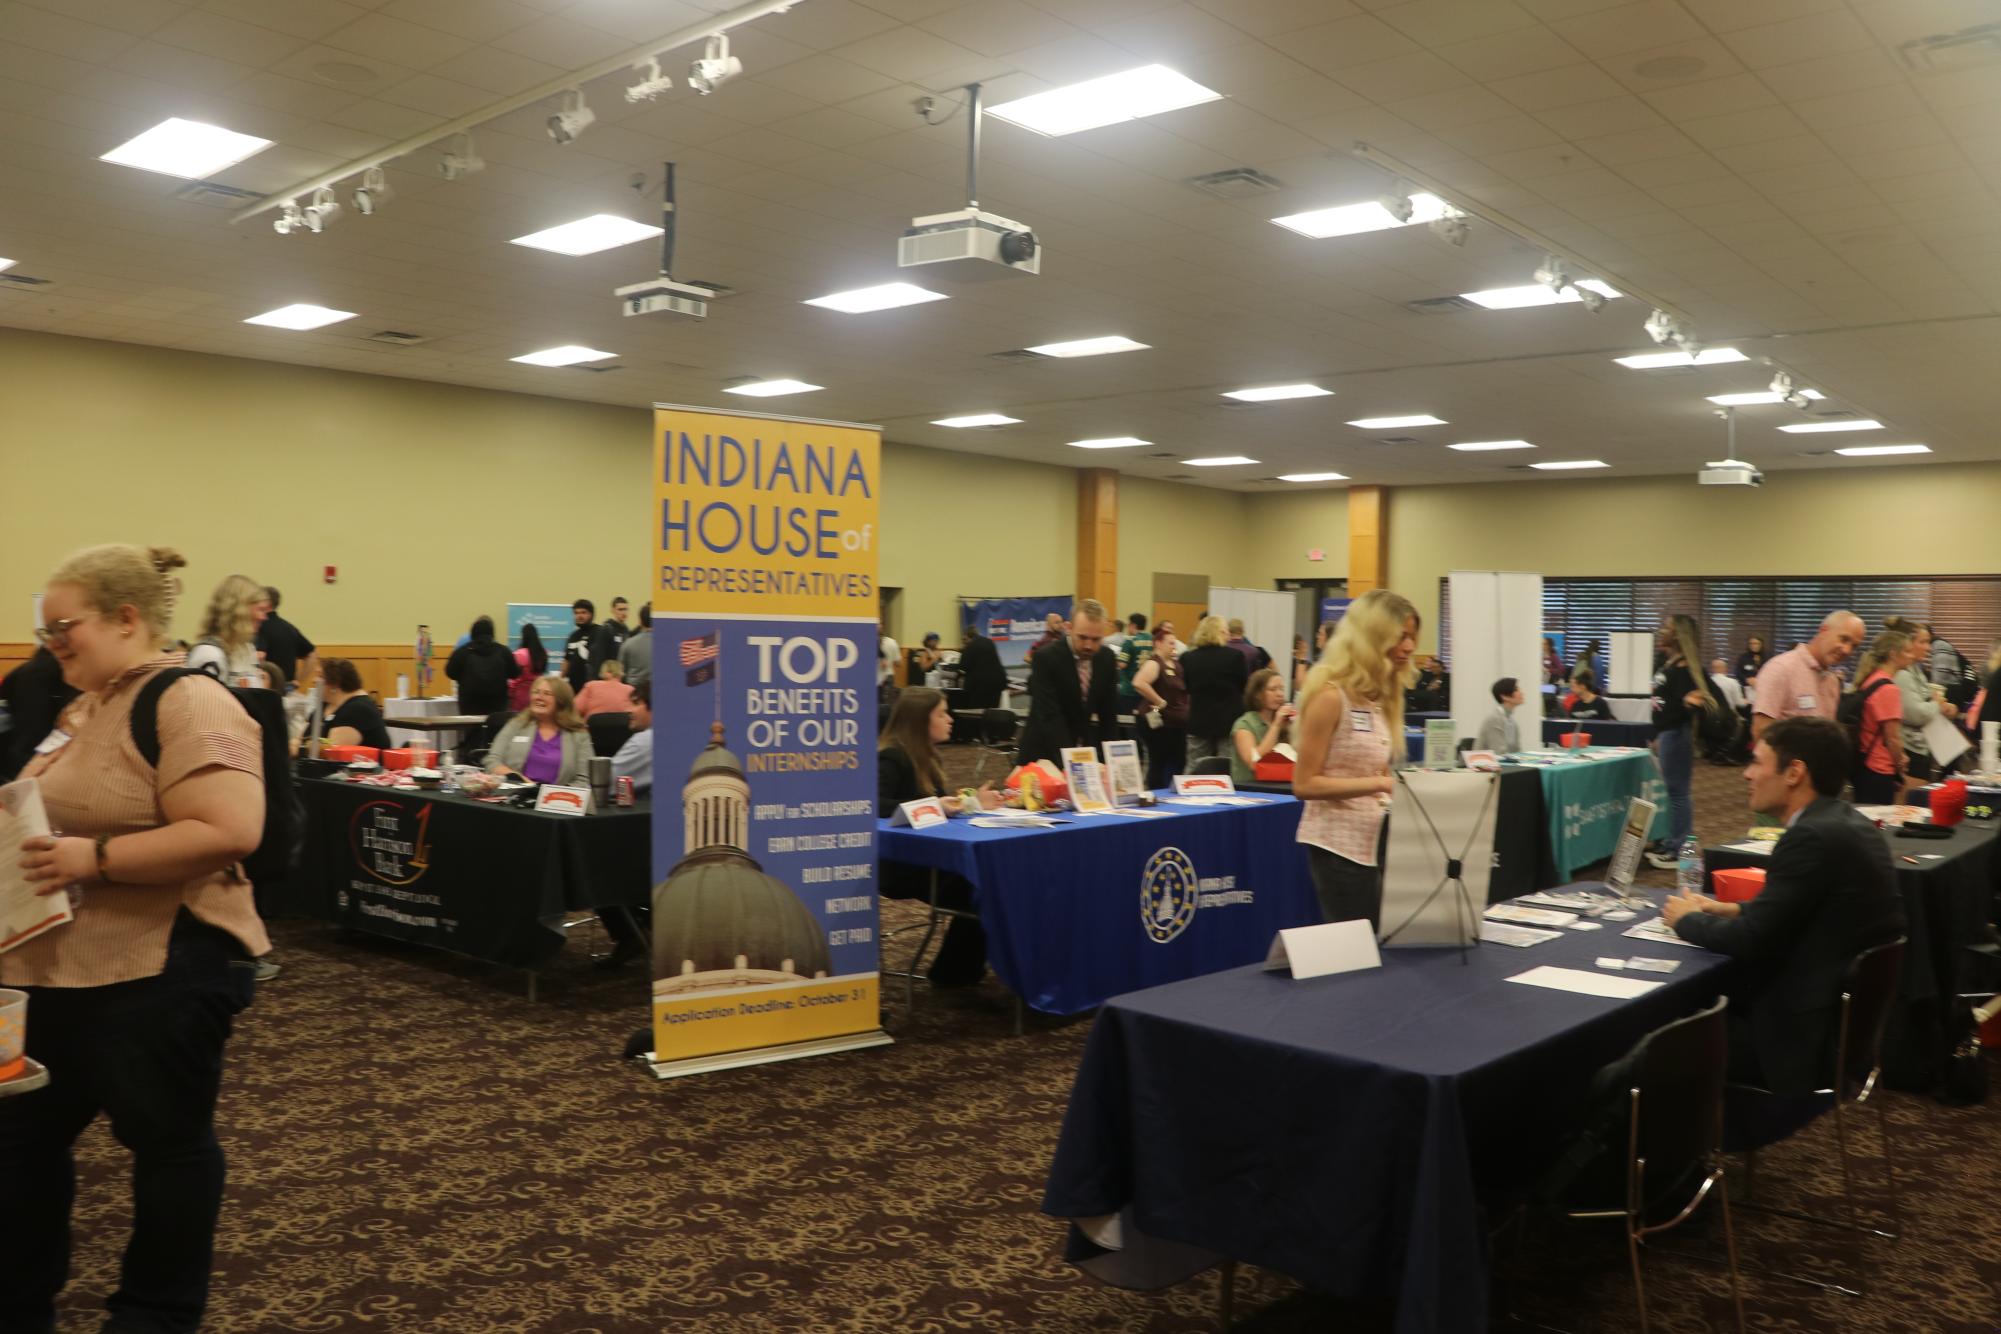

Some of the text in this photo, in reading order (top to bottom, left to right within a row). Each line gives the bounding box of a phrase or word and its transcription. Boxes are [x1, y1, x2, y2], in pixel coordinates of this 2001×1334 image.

[663, 430, 871, 498] INDIANA
[662, 499, 872, 559] HOUSE of
[661, 565, 873, 598] REPRESENTATIVES
[747, 636, 859, 684] TOP
[747, 688, 859, 714] BENEFITS
[747, 719, 859, 747] OF OUR
[747, 751, 859, 773] INTERNSHIPS
[754, 804, 785, 820] APPLY
[800, 800, 872, 818] SCHOLARSHIPS
[796, 834, 837, 851] COLLEGE
[838, 832, 872, 848] CREDIT
[802, 864, 872, 883] BUILD RESUME
[825, 896, 872, 914] NETWORK
[829, 928, 872, 945] GET PAID
[662, 1006, 736, 1024] Application
[739, 998, 794, 1016] Deadline:
[799, 991, 848, 1008] October
